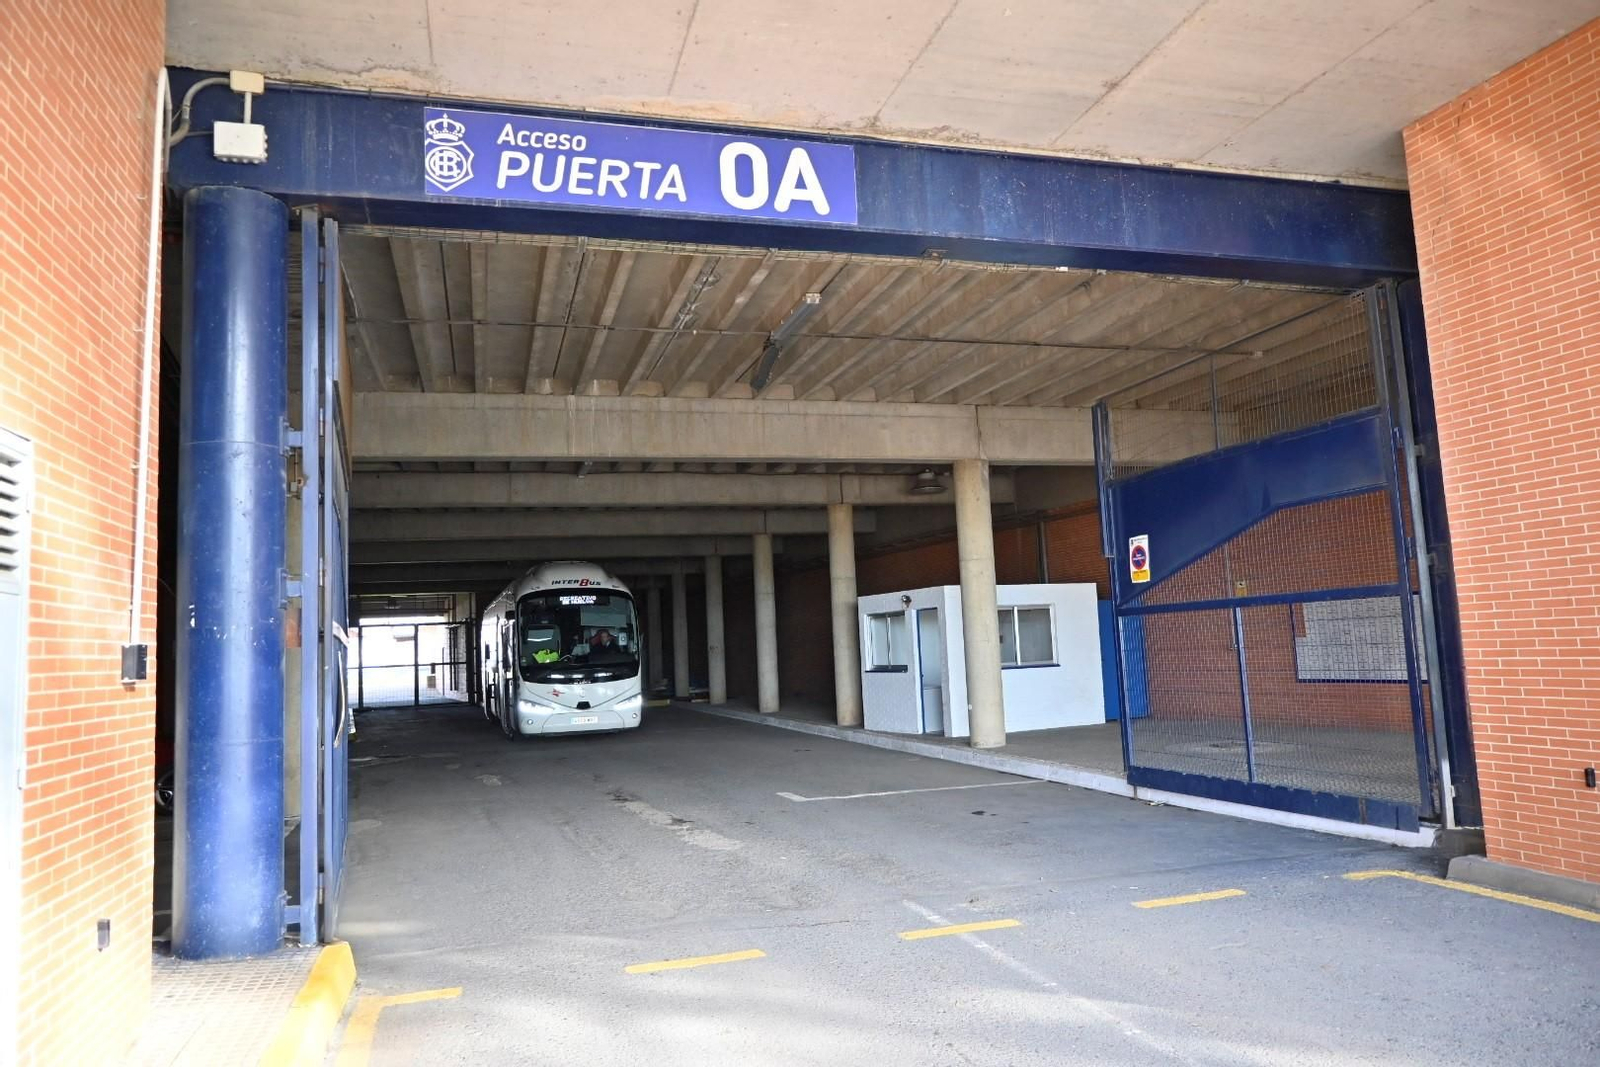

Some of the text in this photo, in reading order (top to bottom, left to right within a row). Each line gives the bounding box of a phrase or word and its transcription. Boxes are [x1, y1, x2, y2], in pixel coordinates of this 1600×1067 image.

[497, 123, 586, 152] Acceso
[497, 150, 687, 203] PUERTA
[551, 578, 601, 587] INTERBUS
